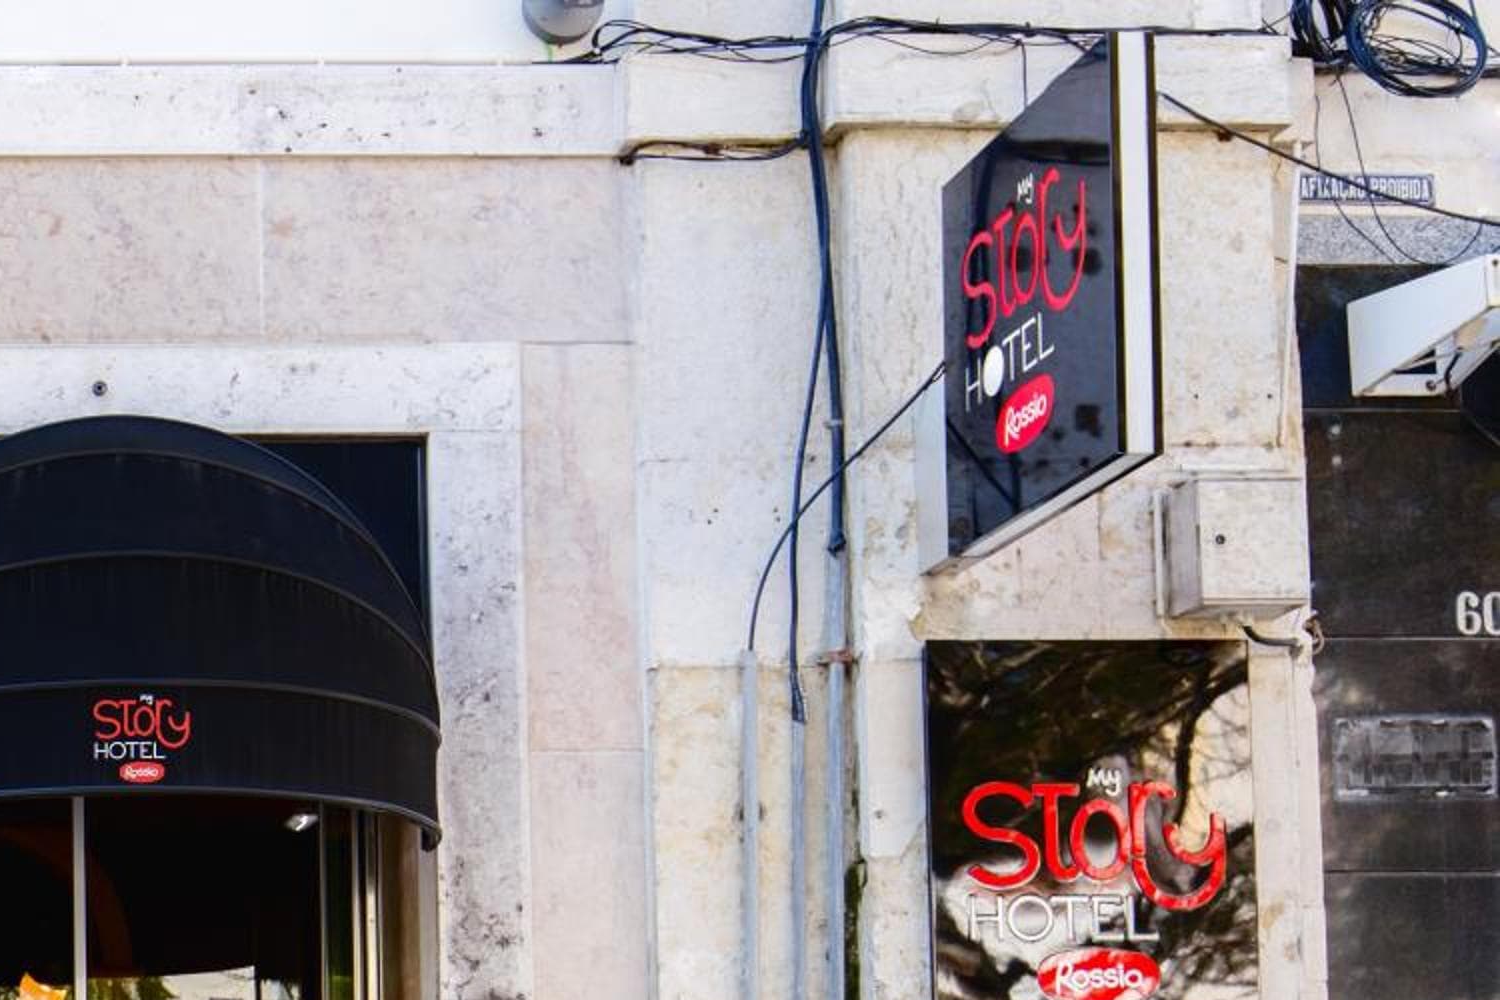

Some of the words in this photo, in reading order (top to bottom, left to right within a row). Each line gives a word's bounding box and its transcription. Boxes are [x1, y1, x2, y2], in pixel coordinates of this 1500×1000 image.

[961, 167, 1087, 348] Story
[965, 312, 1054, 412] HOTEL
[1004, 393, 1048, 447] Rossio
[93, 699, 191, 749] Story
[94, 741, 167, 759] HOTEL
[961, 780, 1227, 910] Story
[968, 893, 1161, 942] HOTEL
[1054, 961, 1145, 995] Rossio
